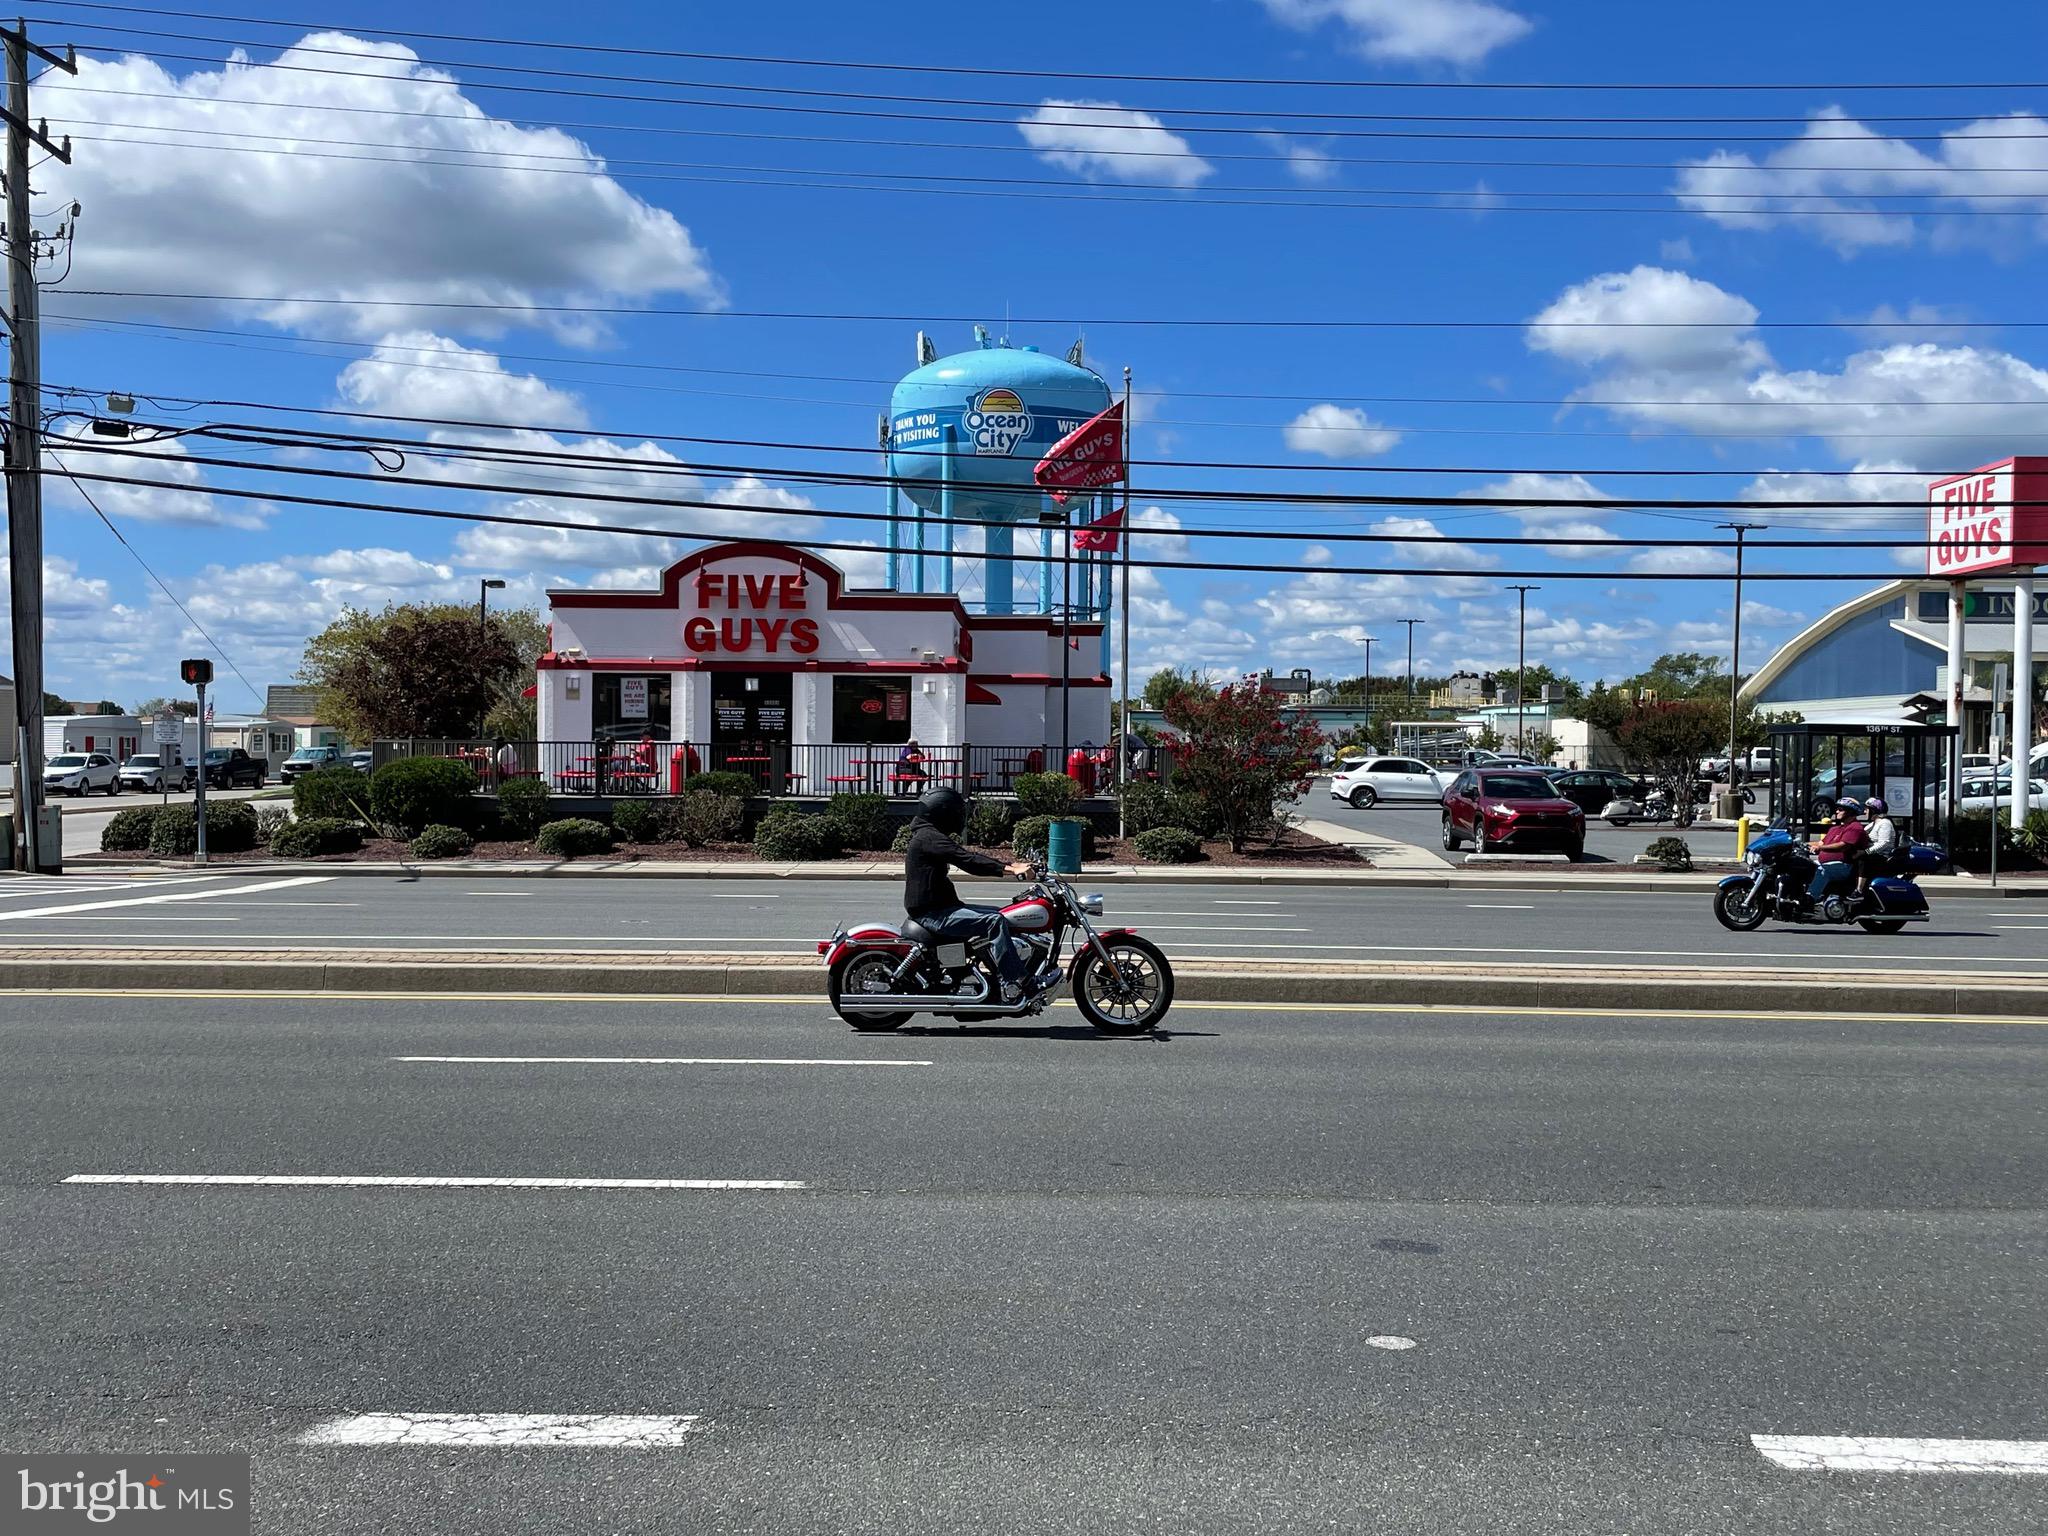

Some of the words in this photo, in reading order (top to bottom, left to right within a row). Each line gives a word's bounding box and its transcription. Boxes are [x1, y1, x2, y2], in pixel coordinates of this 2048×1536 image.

[903, 427, 939, 443] VISITING
[916, 413, 936, 426] YOU
[966, 411, 1029, 430] Ocean
[975, 428, 1019, 454] City
[1043, 454, 1073, 480] FIVE
[1074, 432, 1113, 460] GUYS
[1944, 476, 1996, 524] FIVE
[1937, 517, 2002, 566] GUYS
[698, 574, 806, 609] FIVE
[684, 617, 819, 654] GUYS
